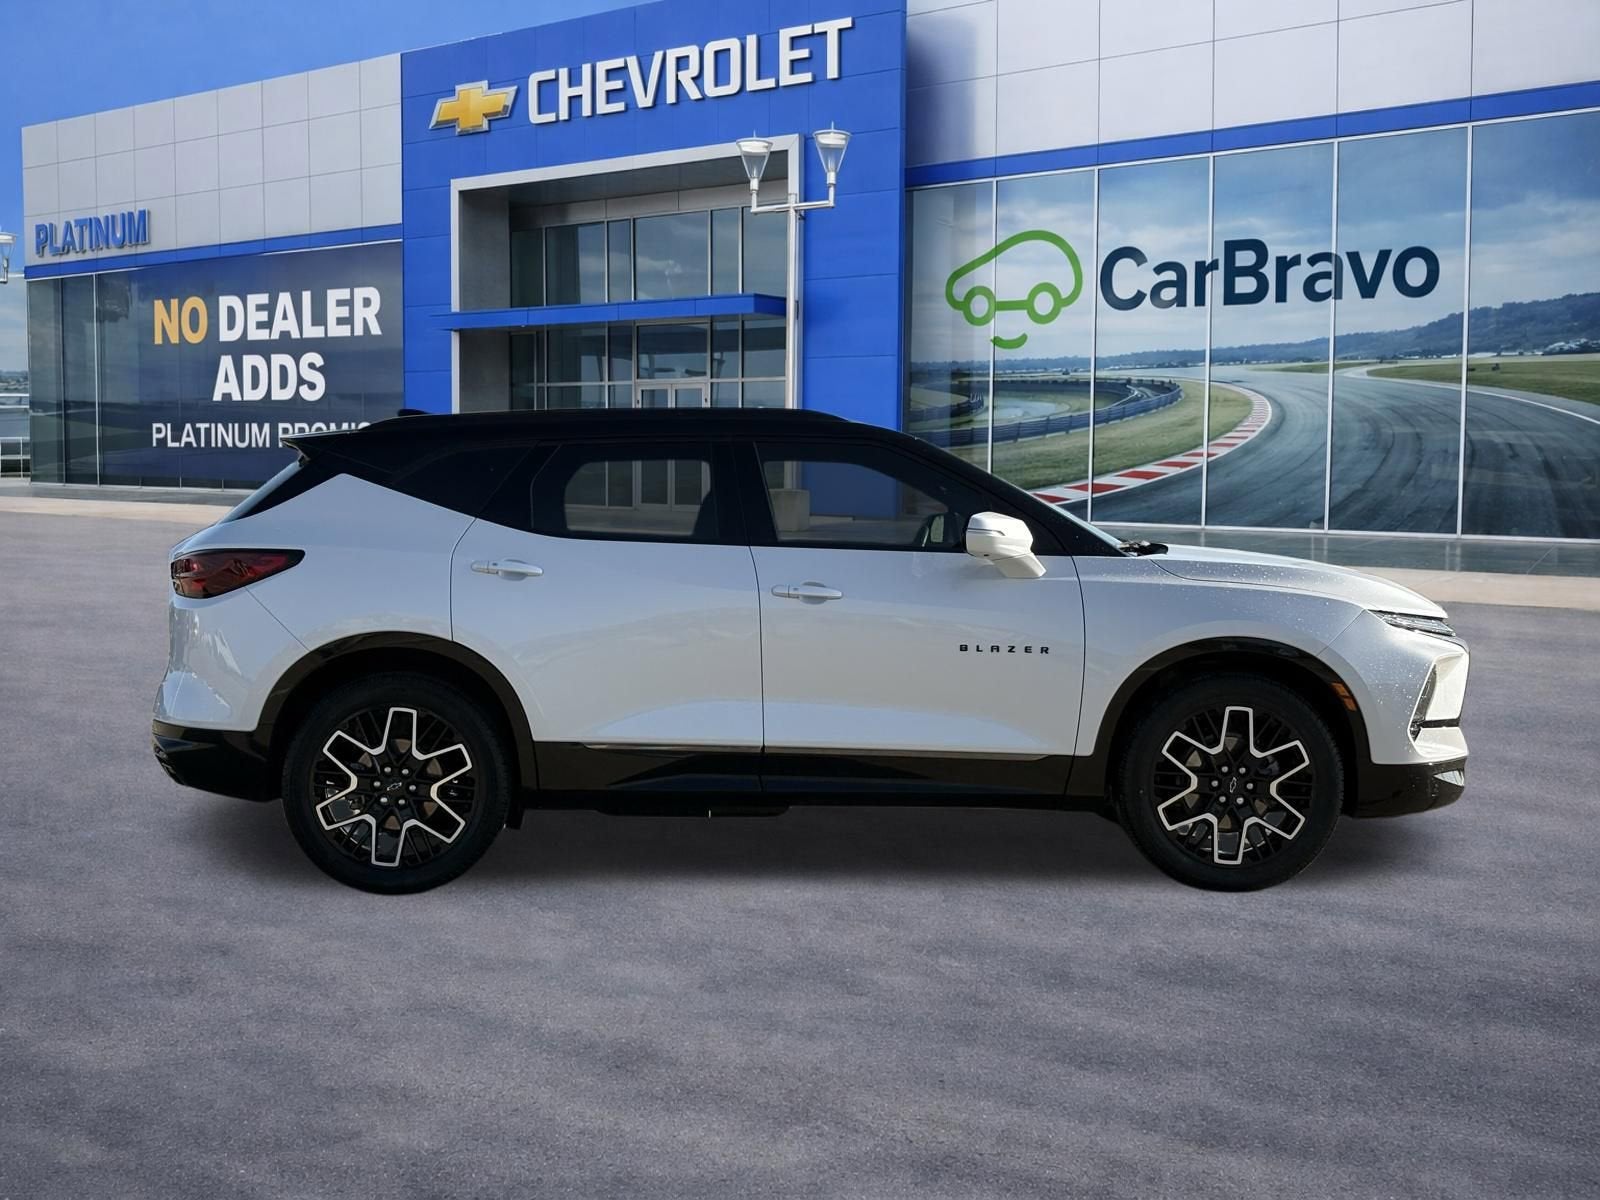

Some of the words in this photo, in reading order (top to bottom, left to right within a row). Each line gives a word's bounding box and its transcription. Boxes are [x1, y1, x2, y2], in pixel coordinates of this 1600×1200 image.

[528, 17, 853, 125] CHEVROLET
[34, 208, 150, 257] PLATINUM
[1099, 237, 1440, 311] CarBravo
[153, 296, 208, 345] NO
[218, 286, 382, 342] DEALER
[212, 352, 326, 402] ADDS
[152, 422, 271, 448] PLATINUM
[959, 644, 1049, 654] BLAZER
